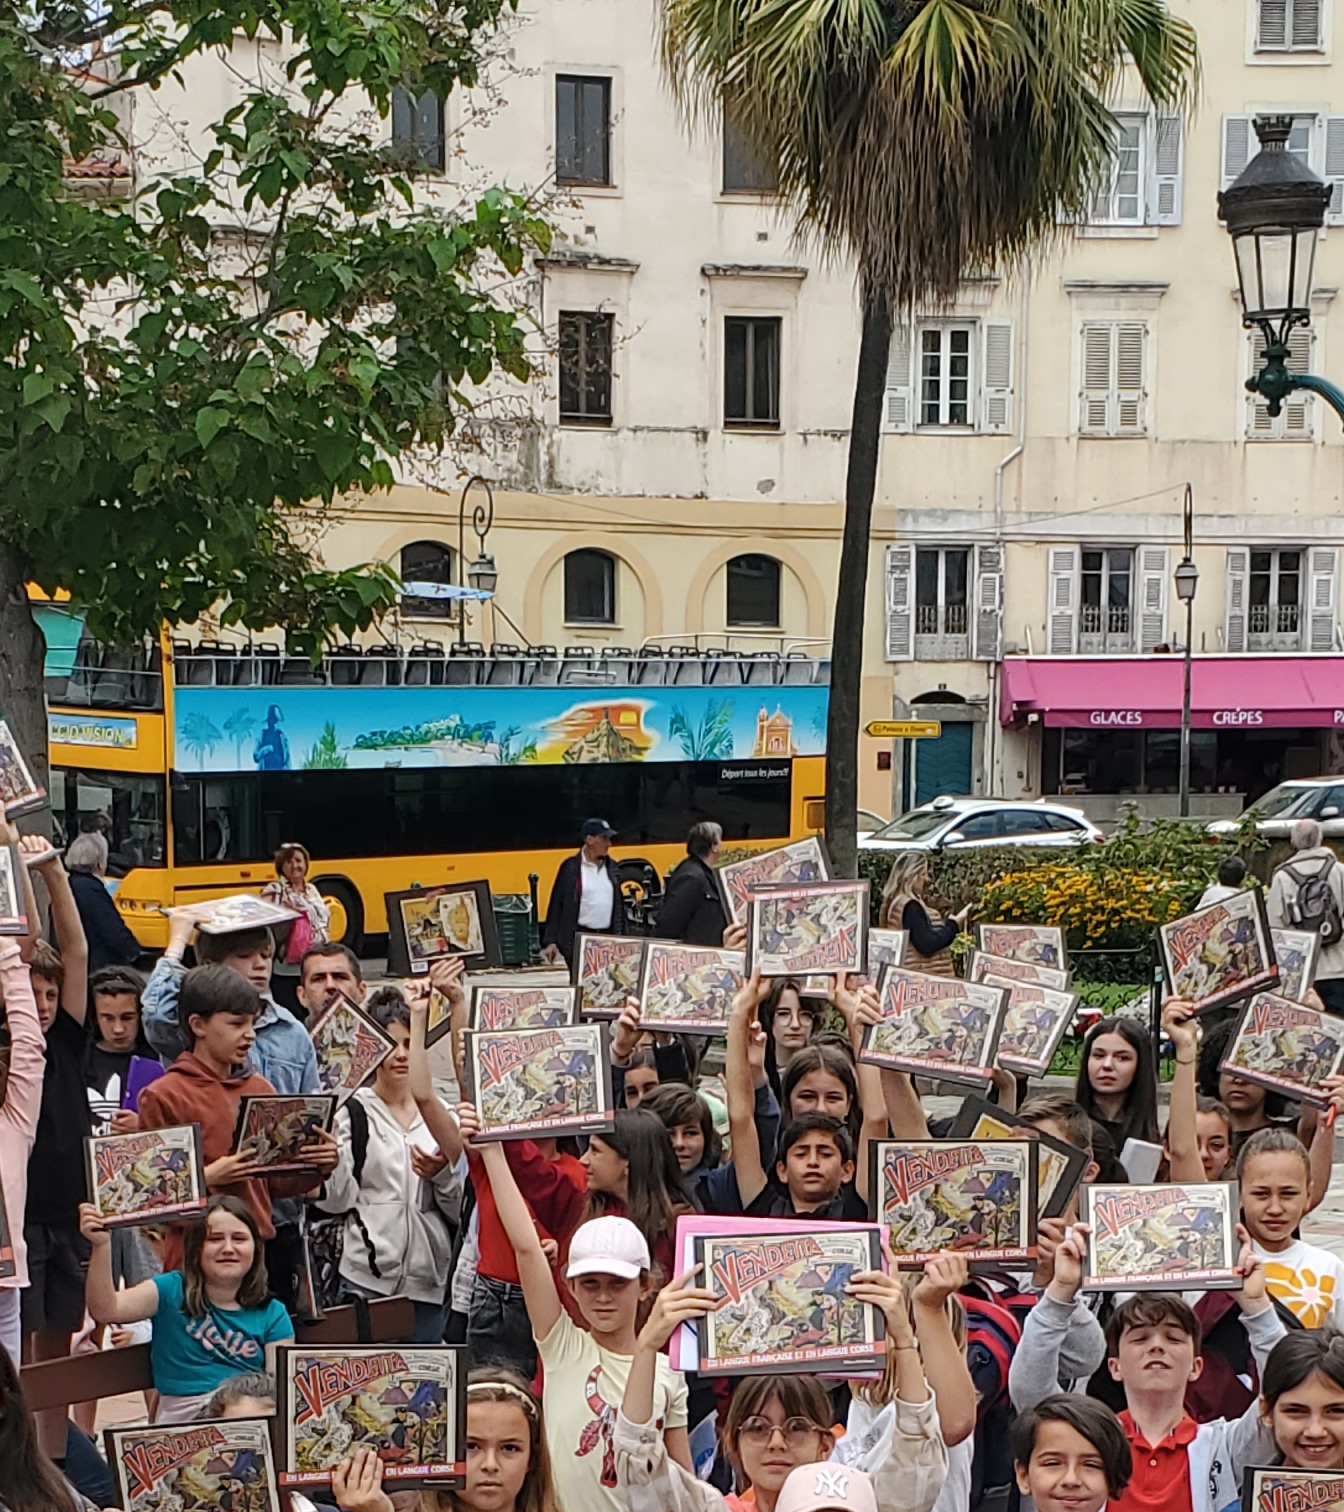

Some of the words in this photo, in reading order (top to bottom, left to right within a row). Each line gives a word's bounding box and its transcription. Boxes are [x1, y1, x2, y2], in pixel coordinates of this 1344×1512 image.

[82, 726, 123, 744] VISION
[1091, 712, 1142, 724] GLACES
[884, 1145, 986, 1206] VENDETTA
[1094, 1188, 1190, 1237] VENDETTA
[712, 1237, 824, 1306] VENDETTA
[294, 1352, 409, 1418] VENDETTA
[123, 1426, 228, 1493] VENDETTA
[814, 1468, 849, 1499] NY
